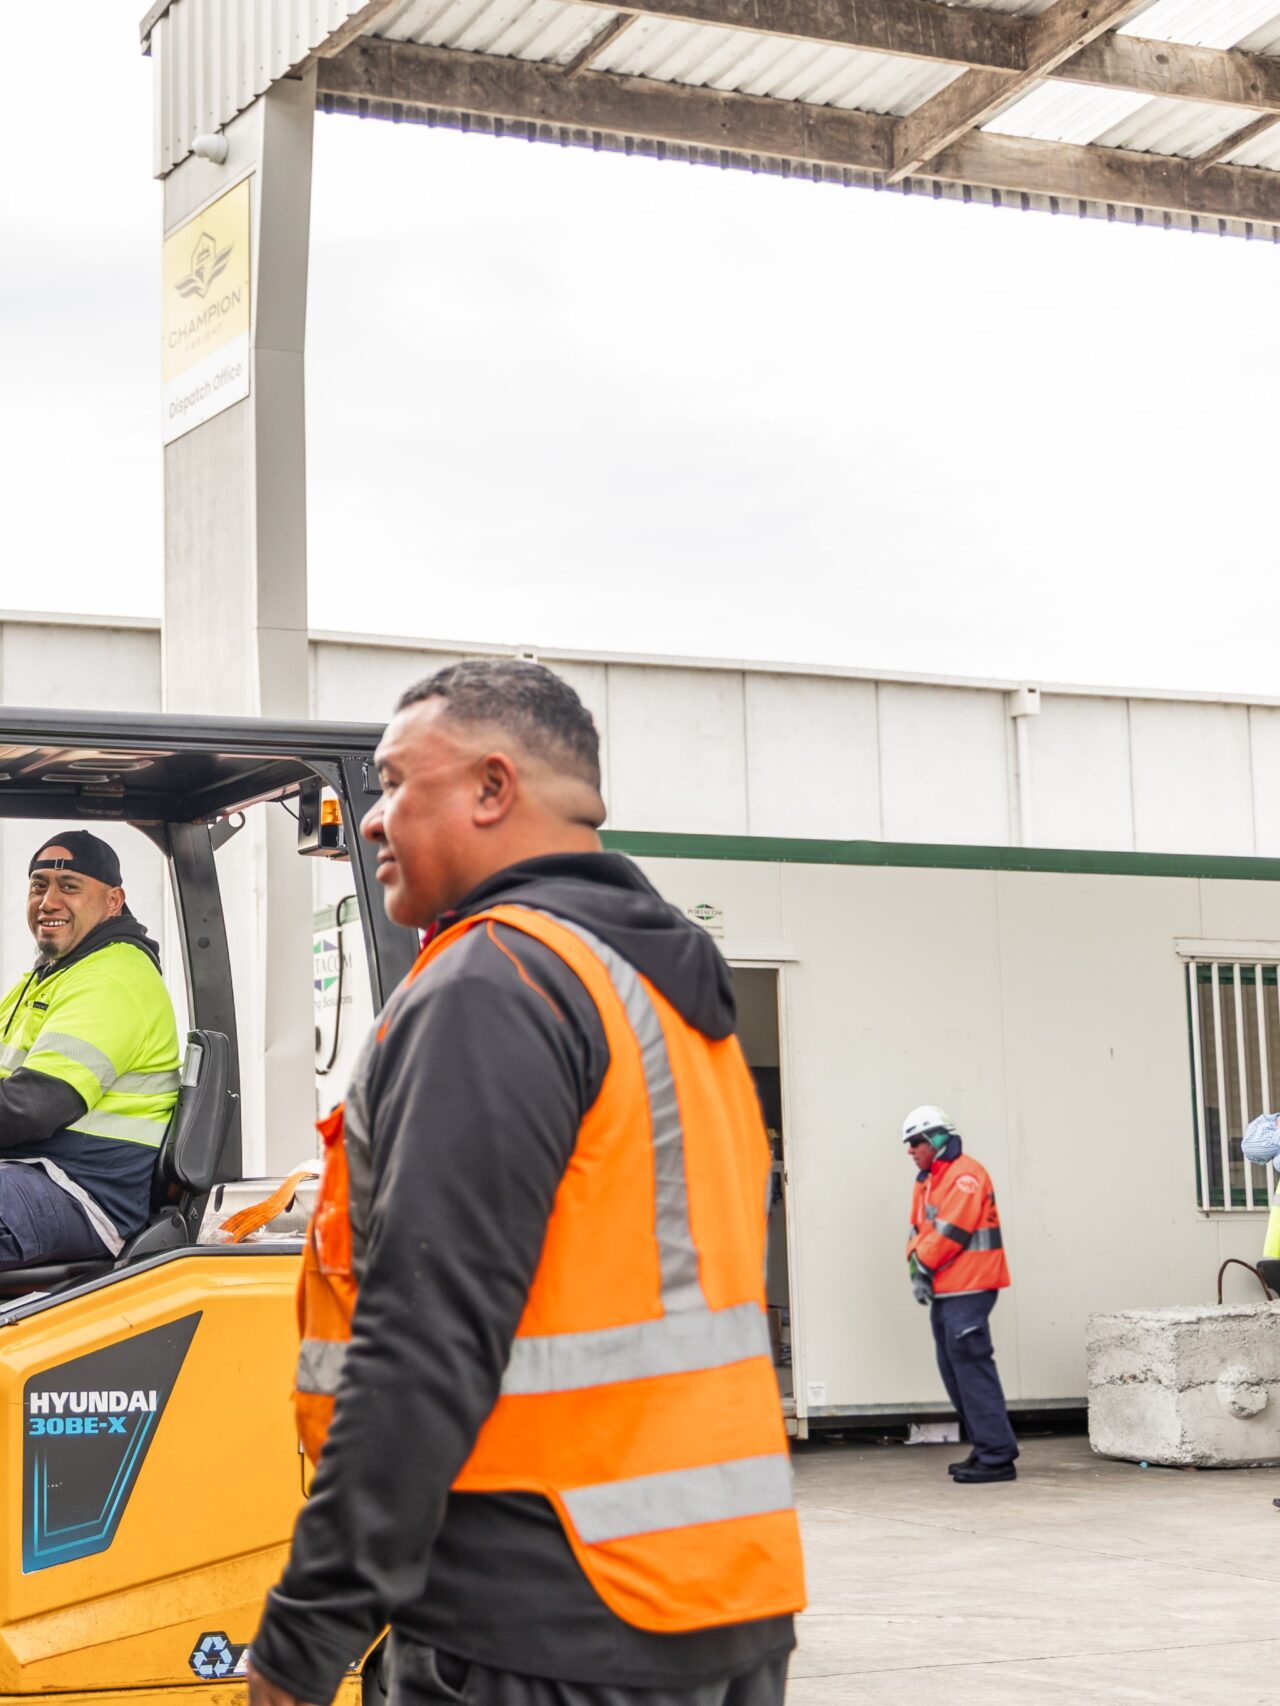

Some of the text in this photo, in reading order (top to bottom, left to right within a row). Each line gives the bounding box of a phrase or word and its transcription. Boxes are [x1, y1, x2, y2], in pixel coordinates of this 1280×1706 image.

[168, 287, 242, 349] CHAMPION
[169, 363, 242, 419] Dispatch Office
[30, 1390, 157, 1414] HYUNDAI
[29, 1416, 127, 1435] 30BE-X
